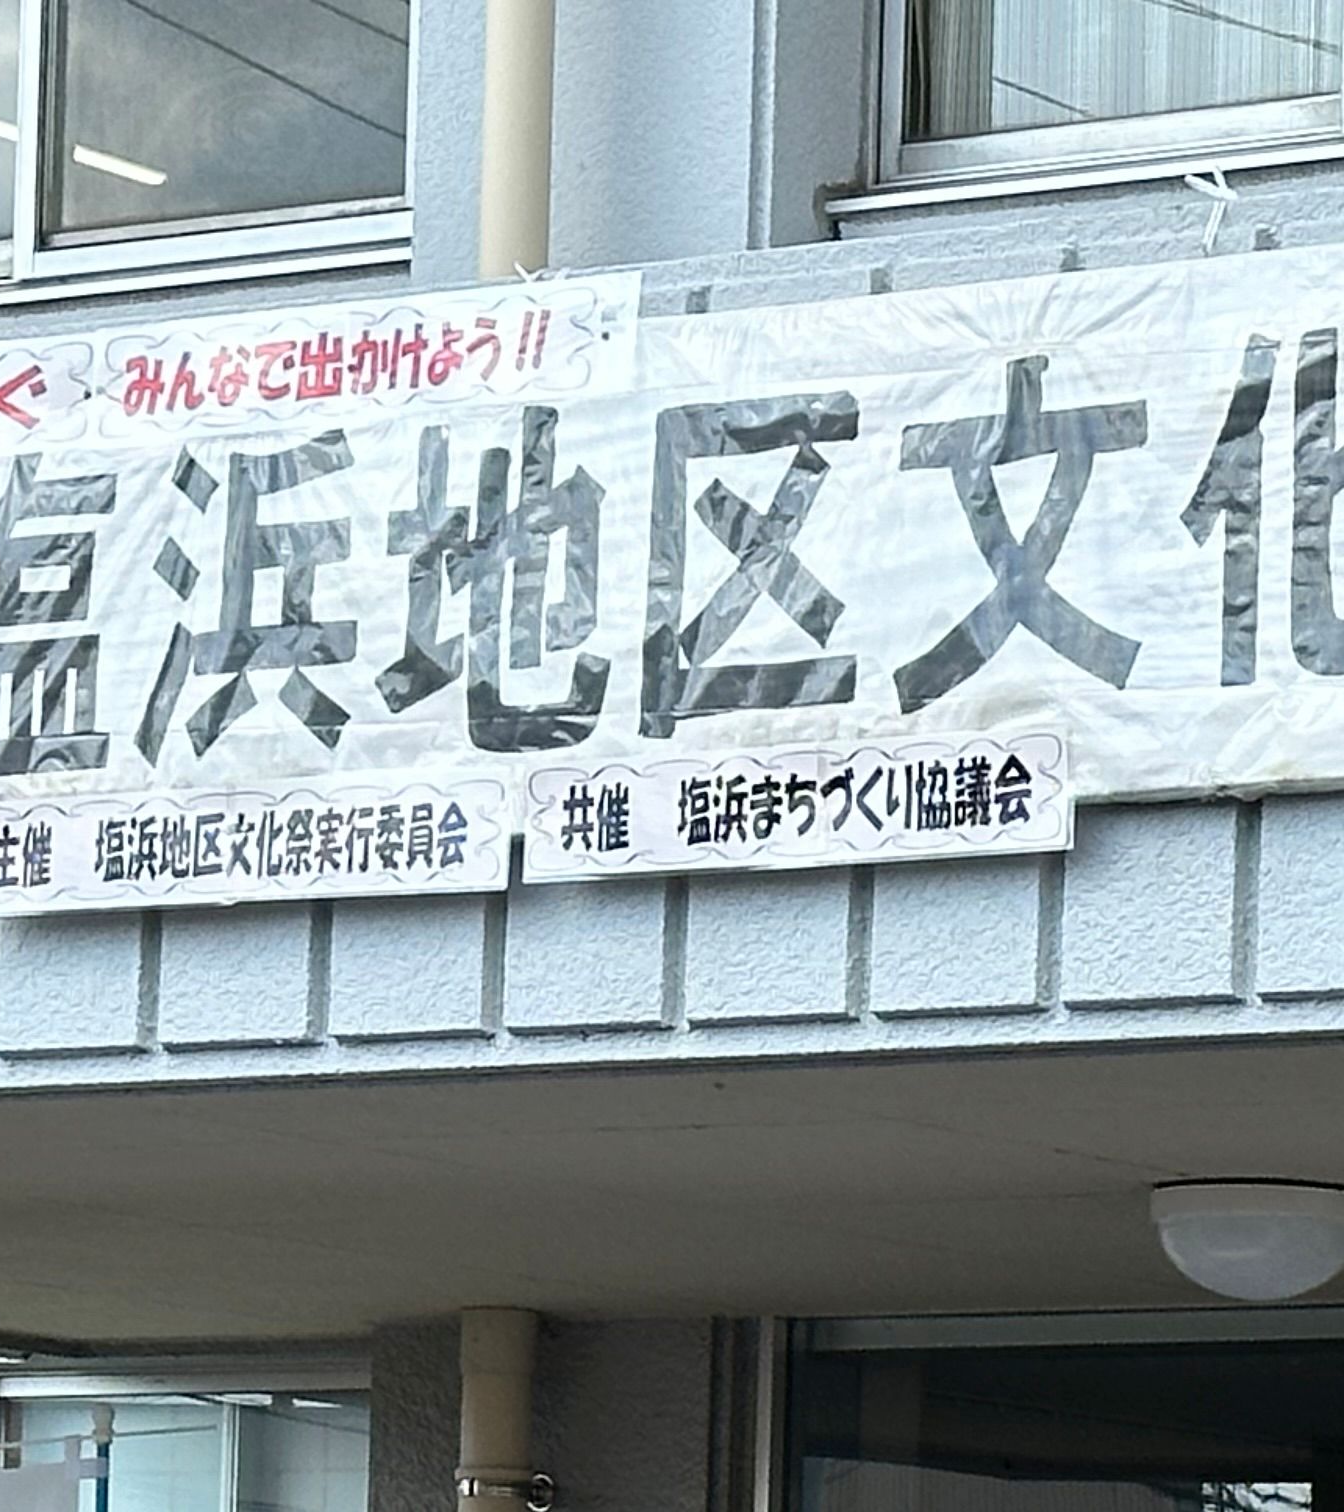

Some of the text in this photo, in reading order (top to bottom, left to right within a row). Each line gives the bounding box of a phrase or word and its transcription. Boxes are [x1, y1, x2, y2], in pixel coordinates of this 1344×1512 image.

[94, 801, 468, 883] 塩浜地区文化祭実行委員会
[561, 754, 1032, 853] 共催 塩浜まちづくり協議会
